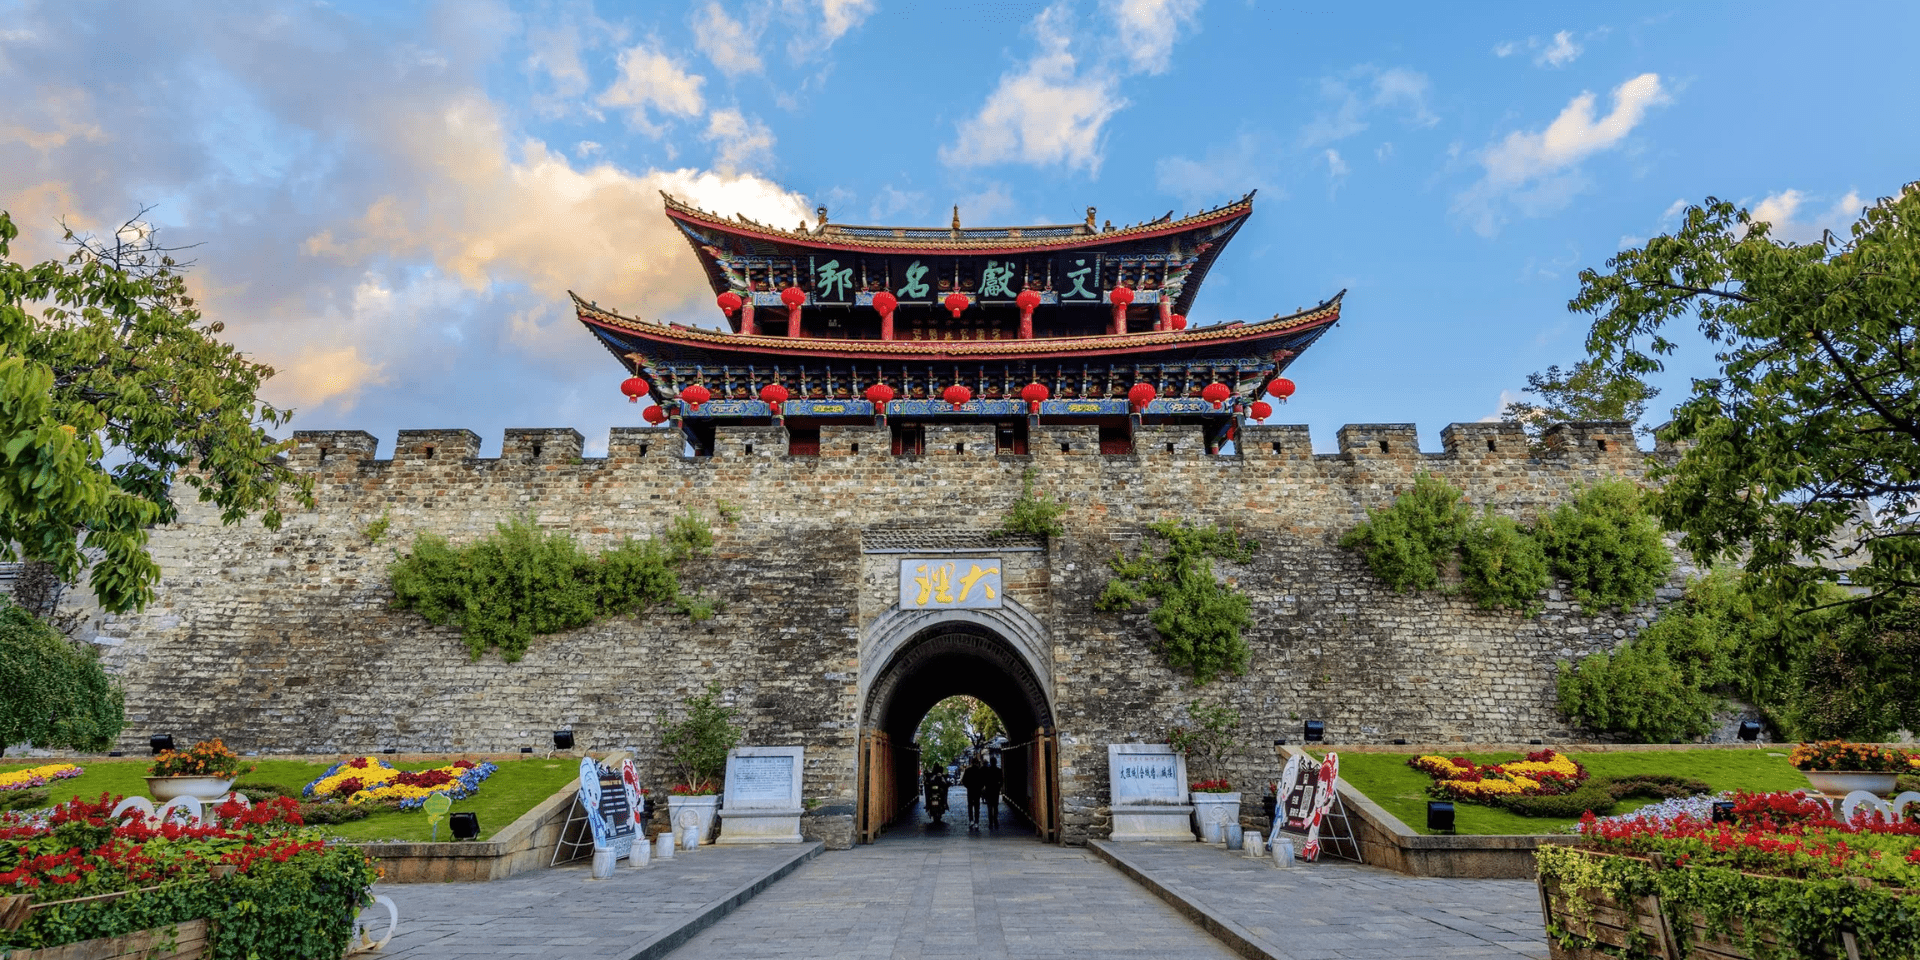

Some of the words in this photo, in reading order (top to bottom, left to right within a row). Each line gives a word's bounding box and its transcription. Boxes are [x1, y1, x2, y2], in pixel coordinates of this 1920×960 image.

[817, 259, 1097, 301] 文獻名邦
[915, 562, 999, 606] 大理
